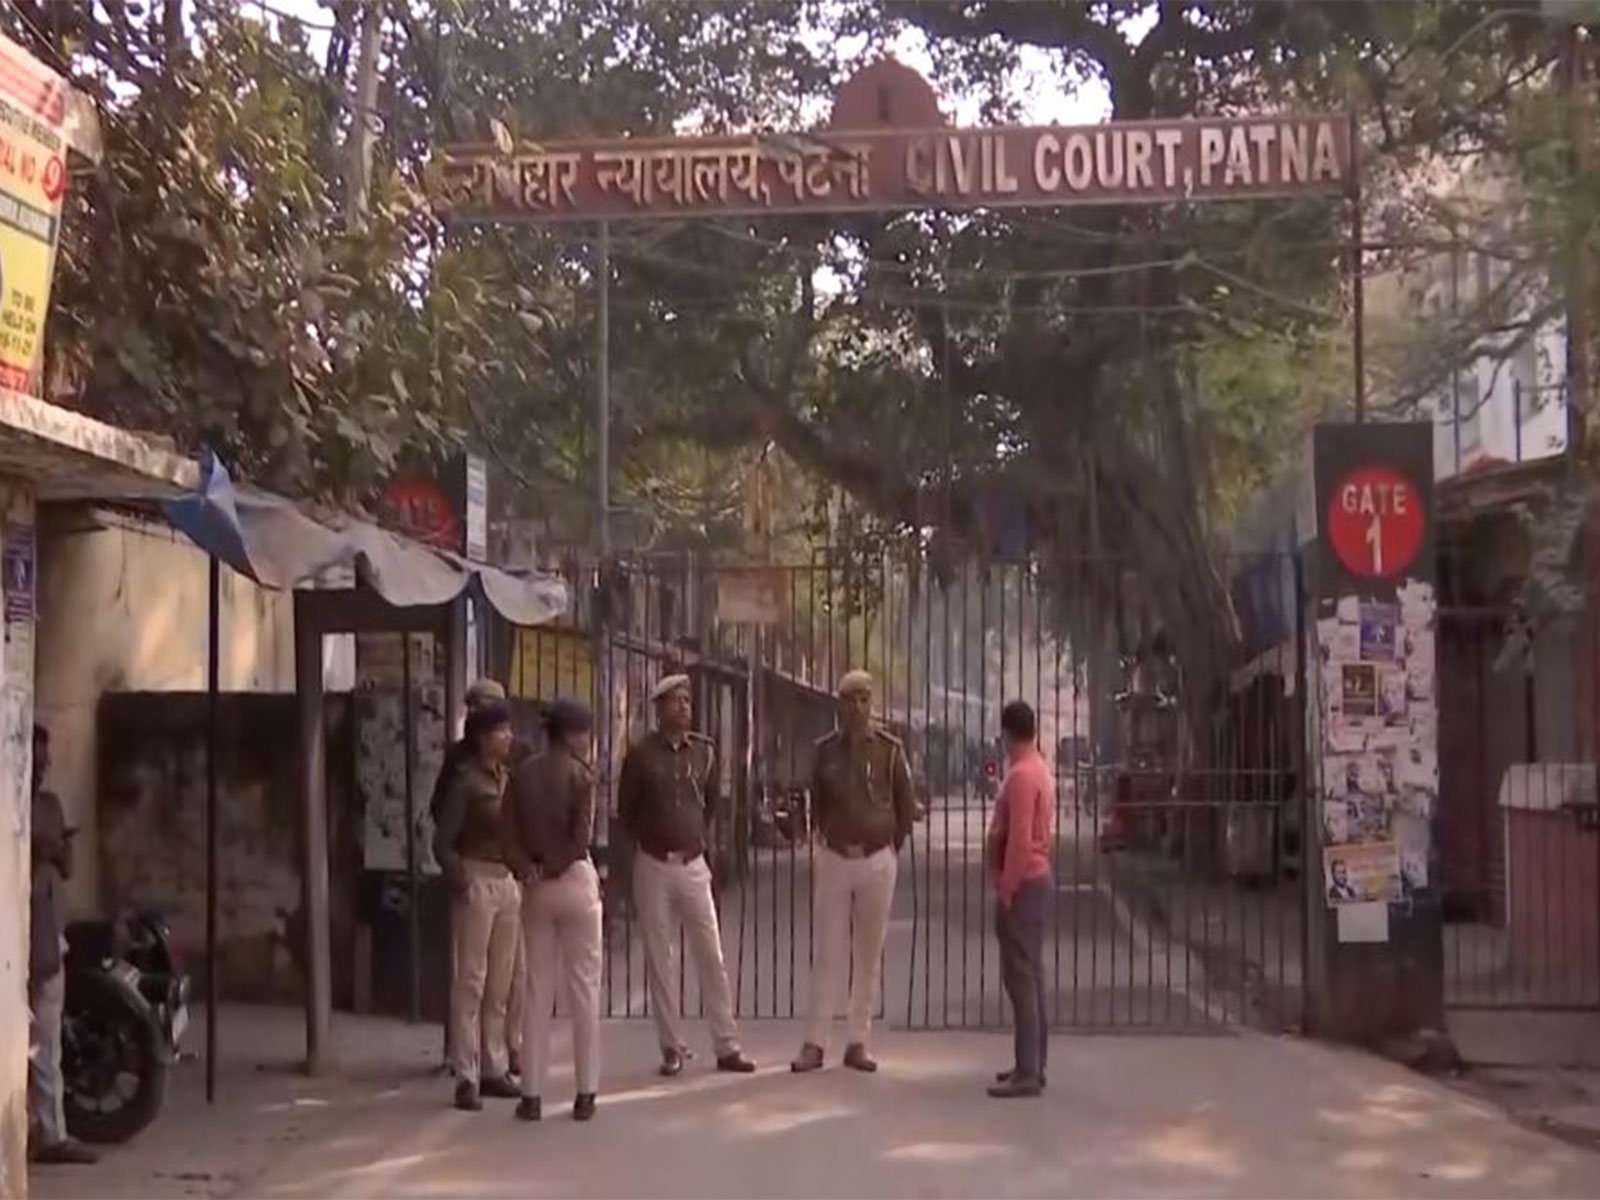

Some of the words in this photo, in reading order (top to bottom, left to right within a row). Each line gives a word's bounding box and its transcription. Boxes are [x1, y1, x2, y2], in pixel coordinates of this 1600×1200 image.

[594, 148, 770, 206] न्यायालय,
[906, 135, 1018, 193] CIVIL
[1342, 483, 1407, 516] GATE
[1365, 515, 1382, 575] 1
